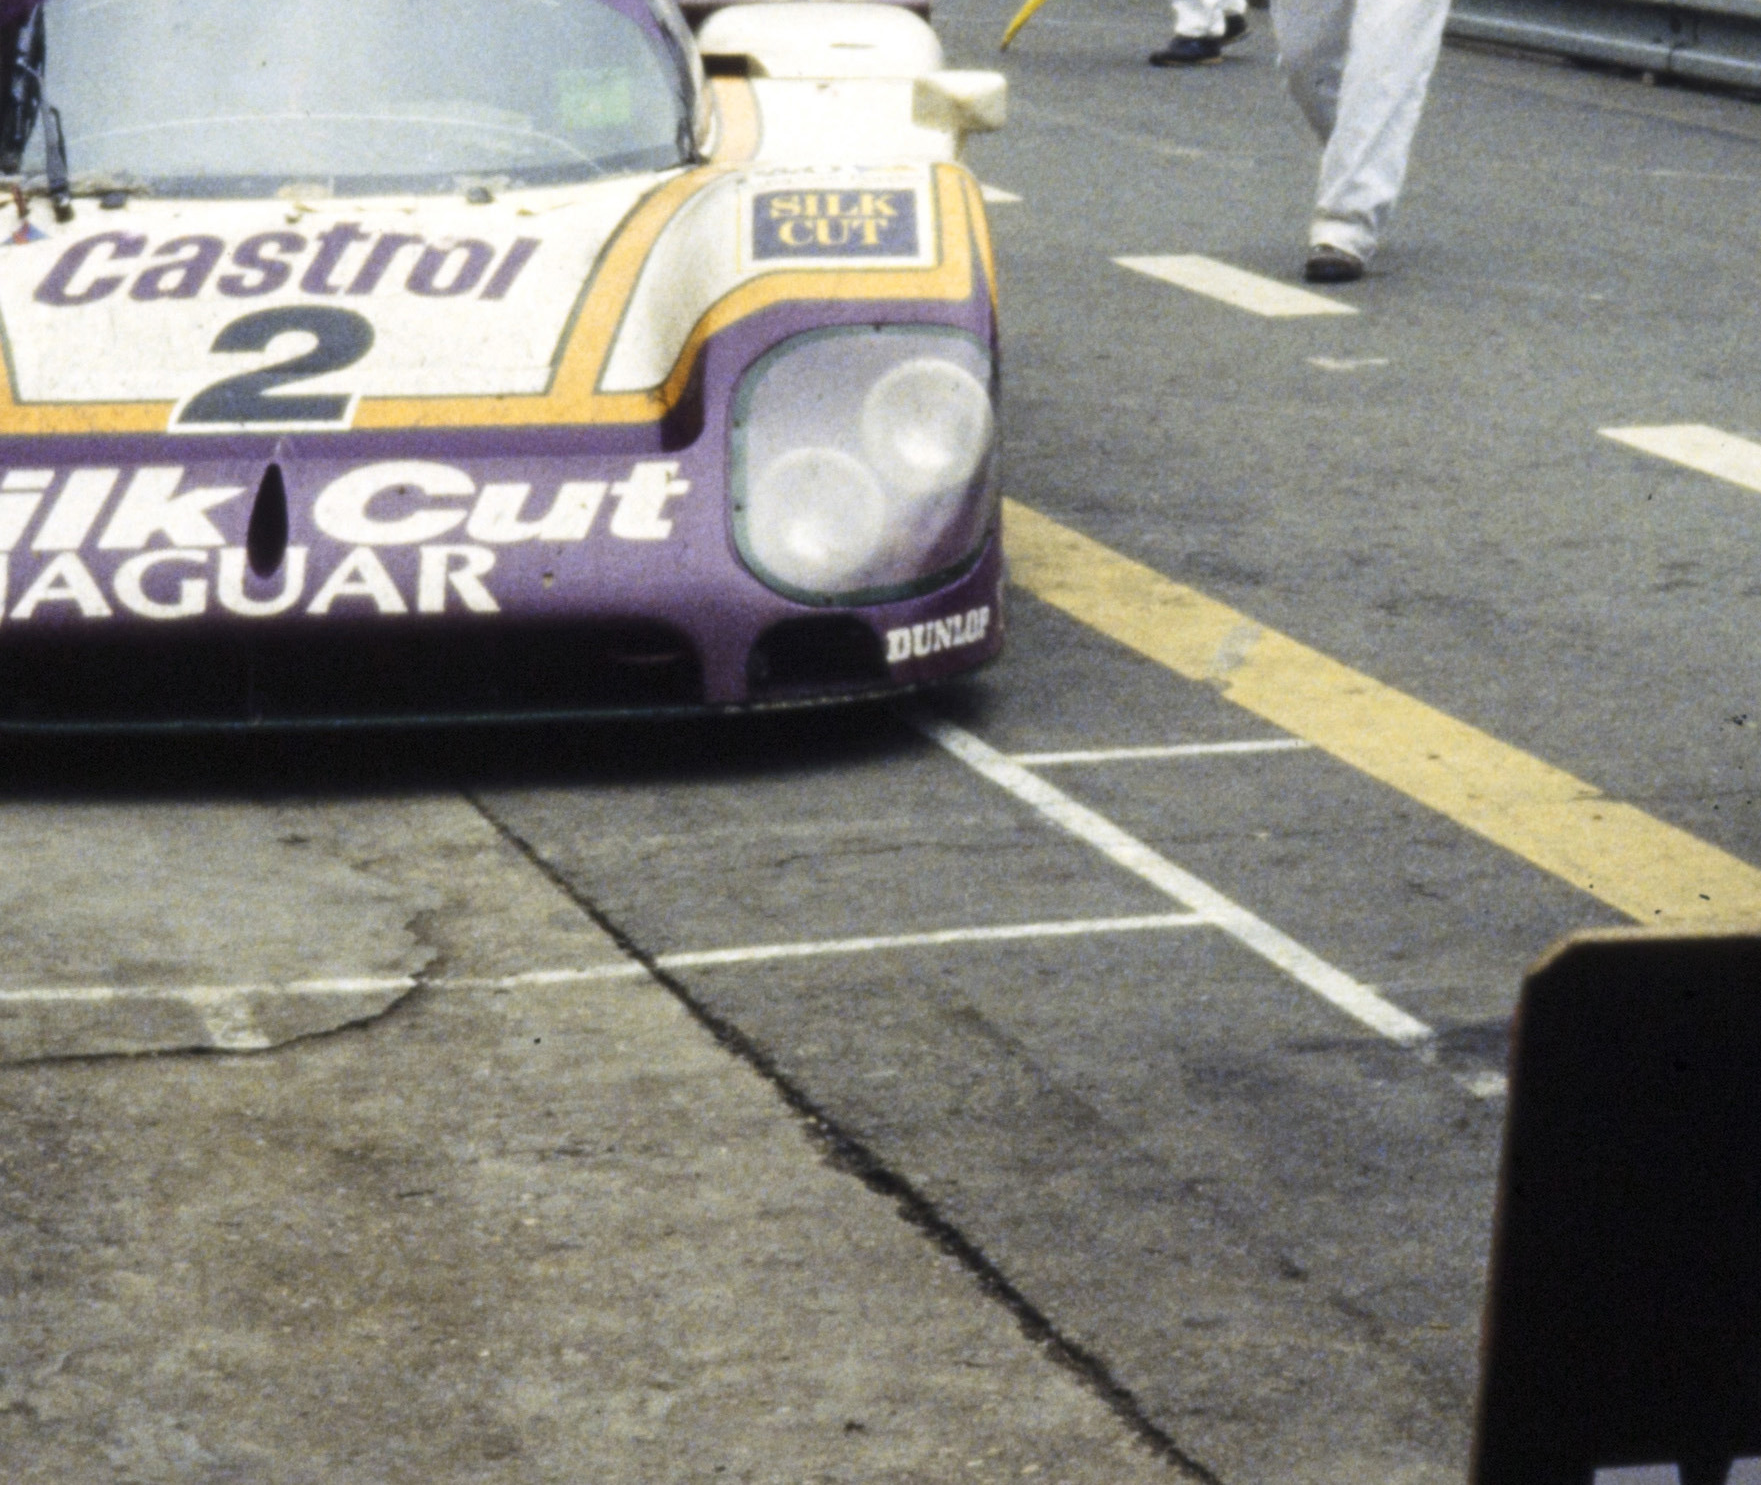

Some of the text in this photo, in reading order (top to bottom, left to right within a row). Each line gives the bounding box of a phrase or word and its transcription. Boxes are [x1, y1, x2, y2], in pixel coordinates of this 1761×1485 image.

[769, 193, 899, 218] SILK
[777, 218, 890, 246] CUT
[32, 220, 542, 307] Castrol
[178, 305, 376, 426] 2
[313, 460, 690, 546] Cut
[886, 605, 991, 664] DUNLOP
